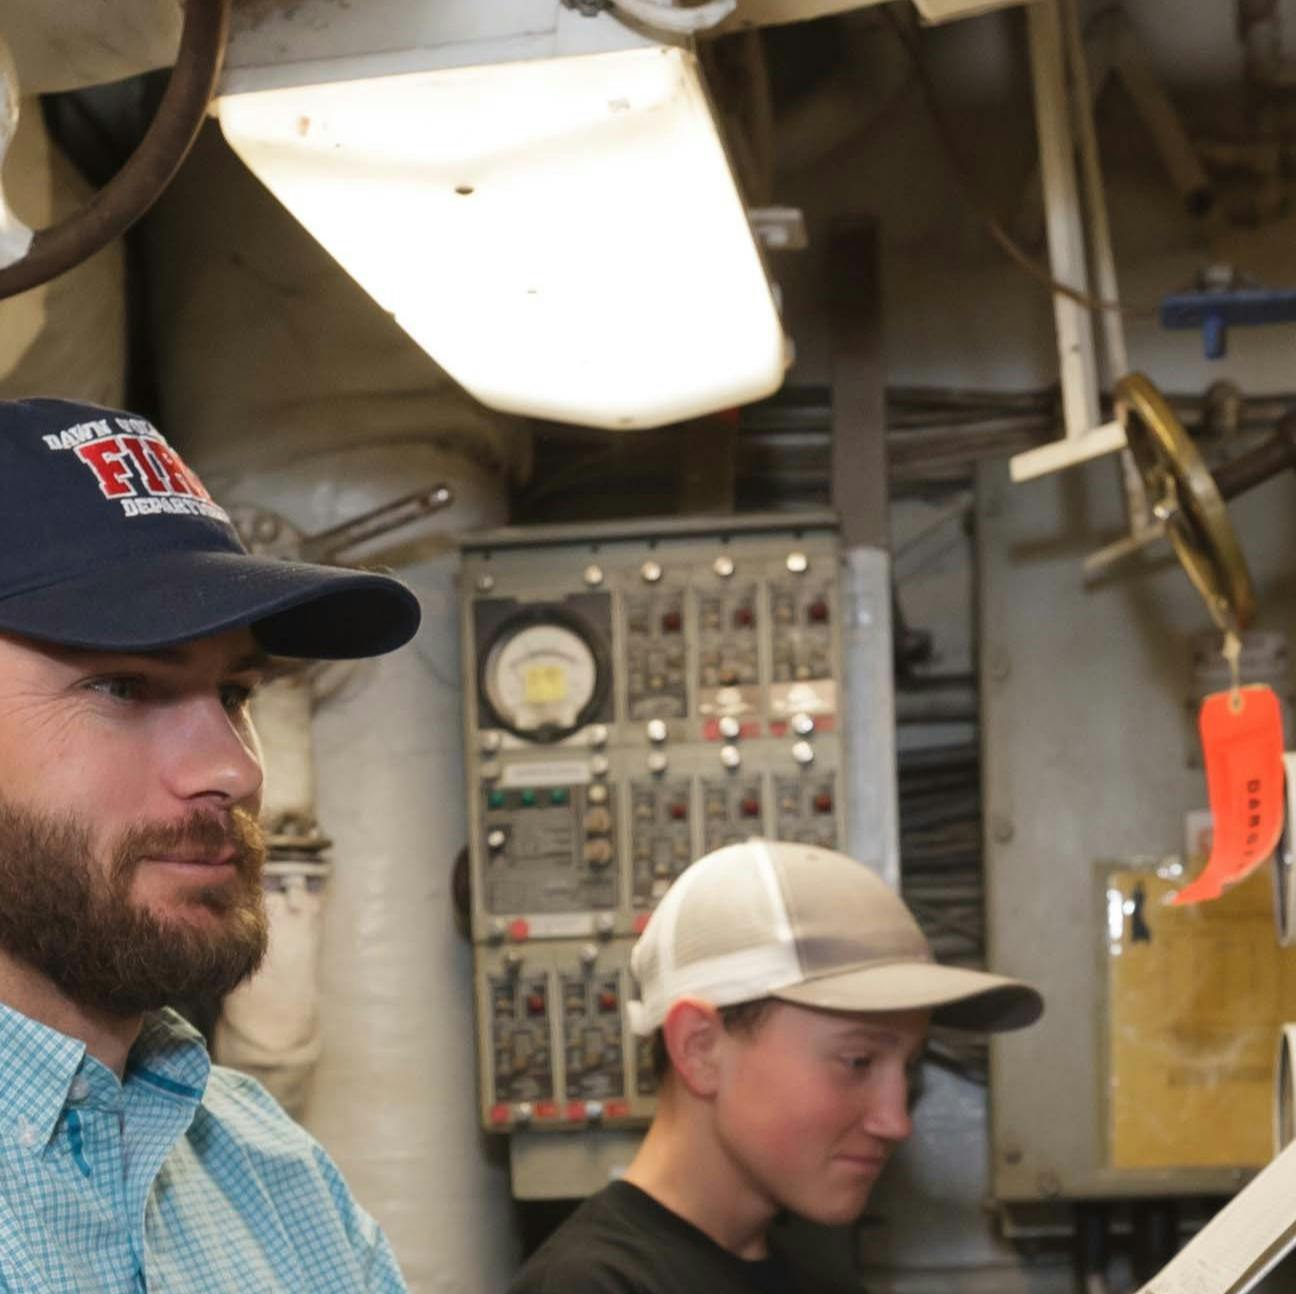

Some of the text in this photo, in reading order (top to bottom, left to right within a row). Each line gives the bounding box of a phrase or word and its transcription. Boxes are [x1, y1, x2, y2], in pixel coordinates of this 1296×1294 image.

[42, 418, 112, 450] DAWN
[73, 433, 215, 501] FIR
[120, 497, 231, 524] DEPART
